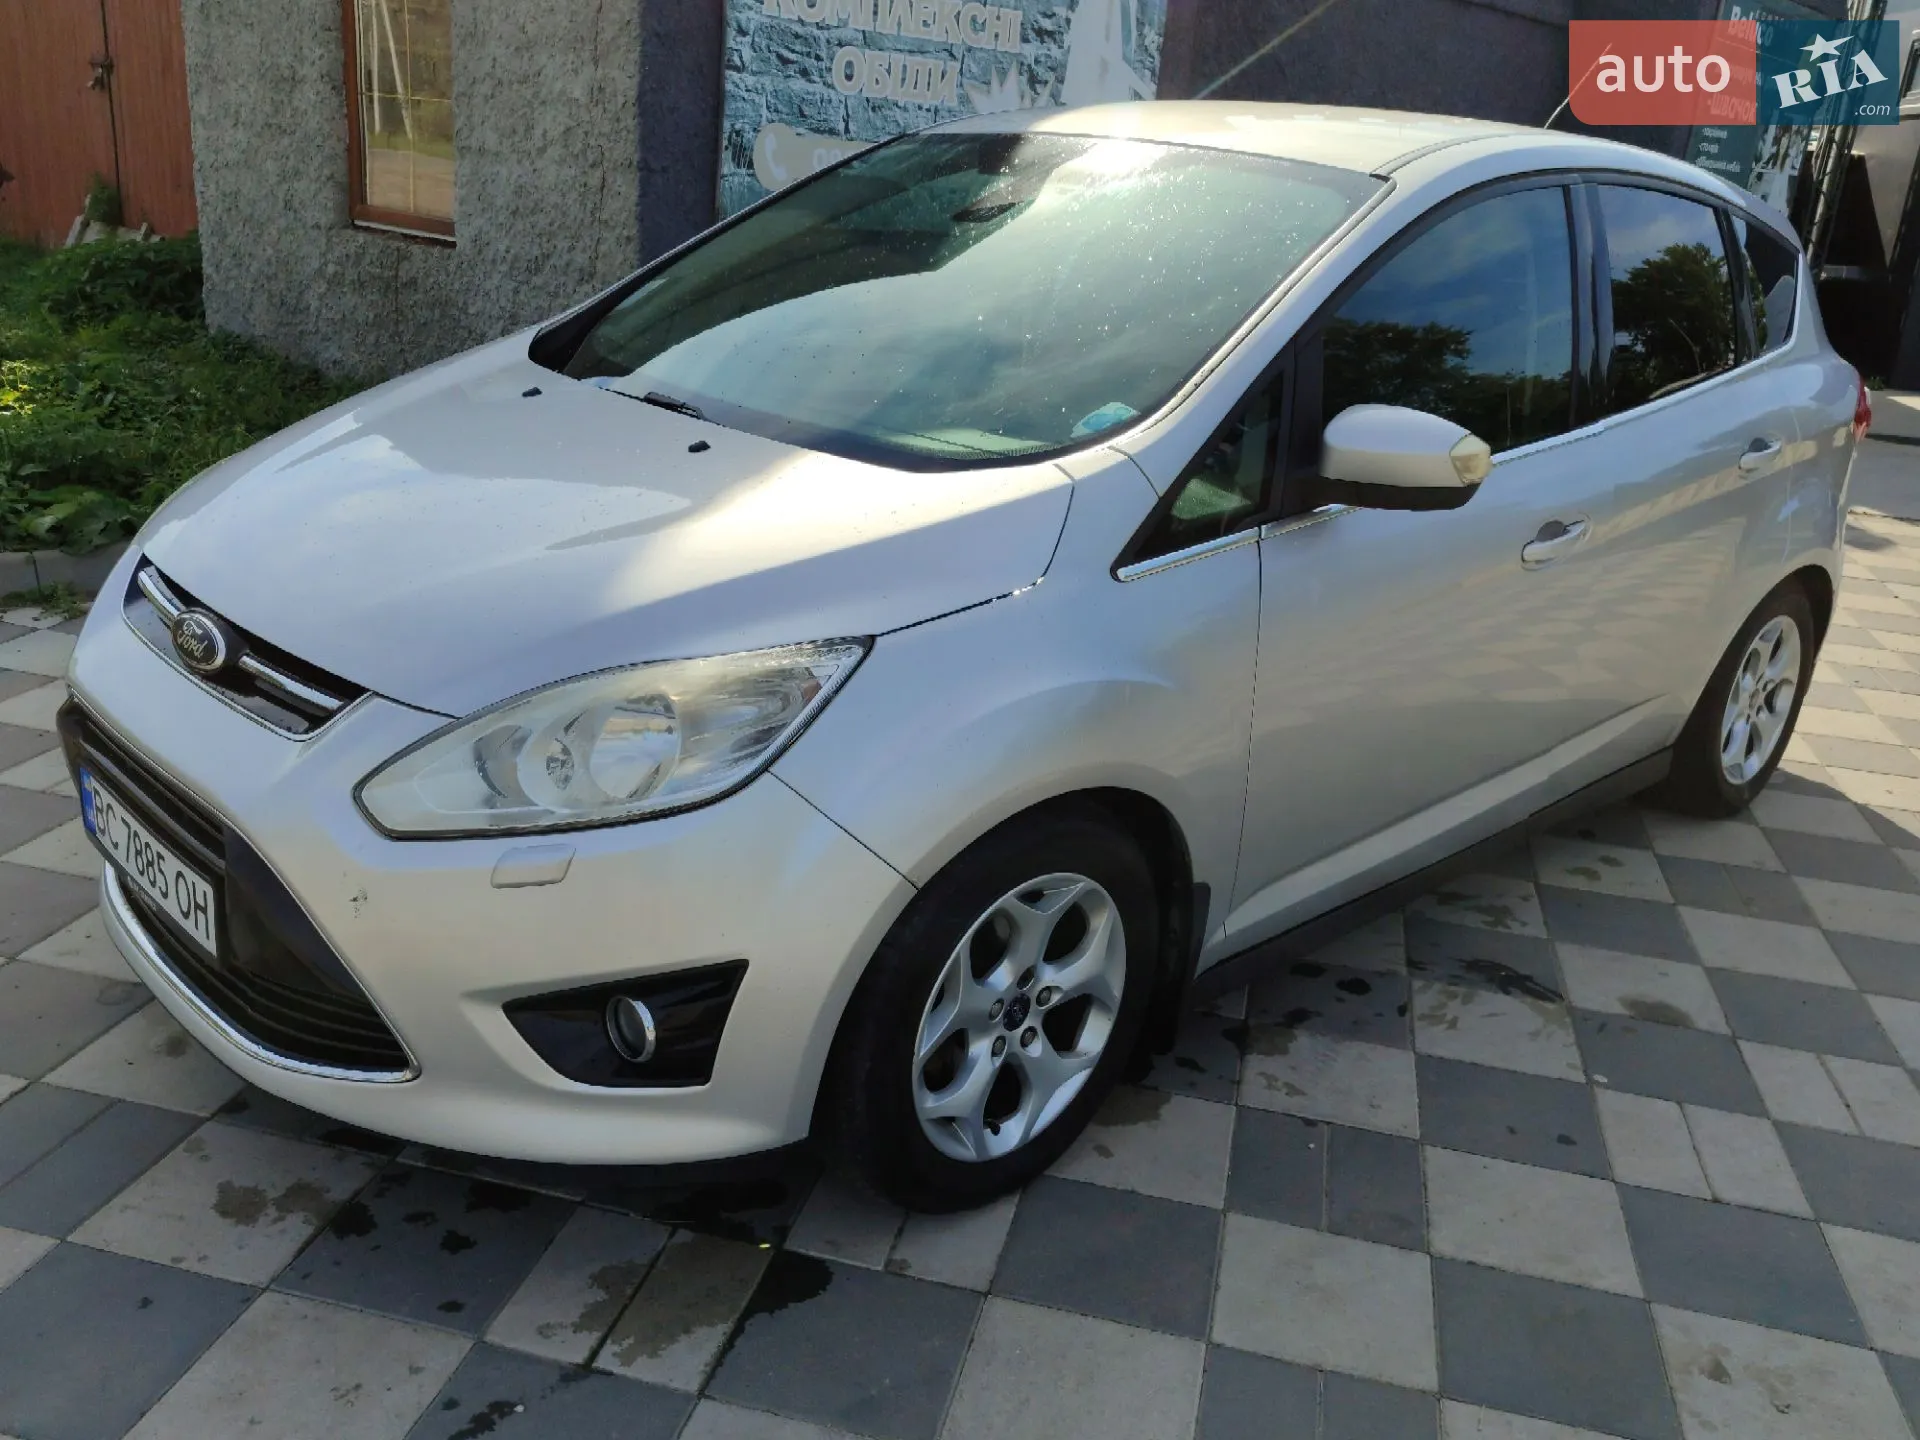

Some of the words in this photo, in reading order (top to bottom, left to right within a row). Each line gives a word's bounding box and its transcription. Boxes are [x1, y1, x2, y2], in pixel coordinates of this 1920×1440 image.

[832, 45, 960, 105] ОБІДИ
[177, 621, 208, 658] Ford
[94, 787, 118, 850] BC
[121, 816, 168, 899] 7885
[175, 871, 209, 940] OH
